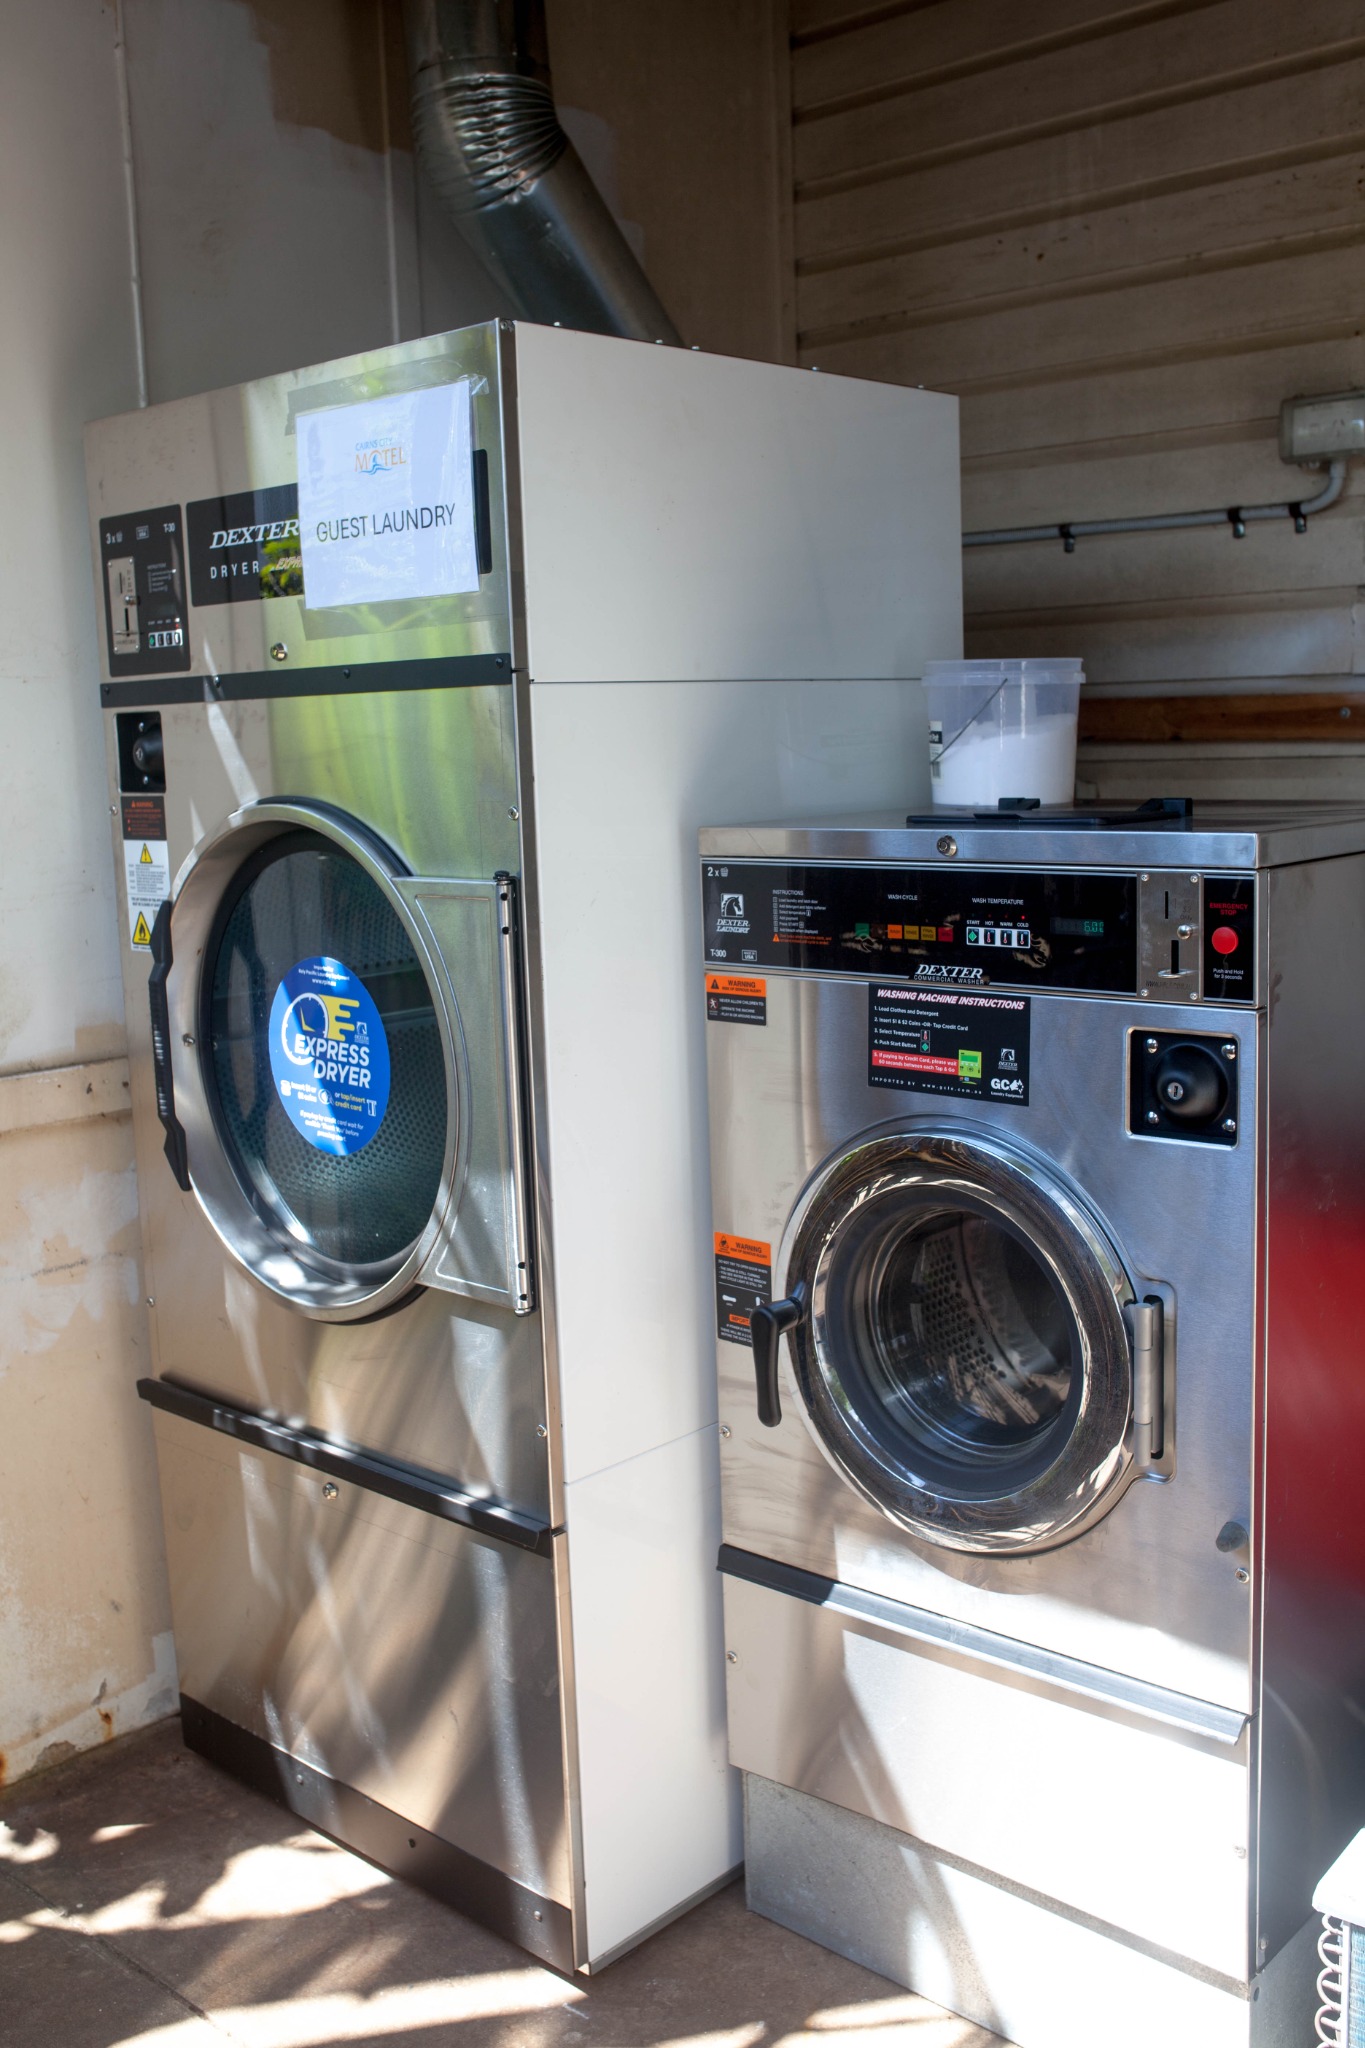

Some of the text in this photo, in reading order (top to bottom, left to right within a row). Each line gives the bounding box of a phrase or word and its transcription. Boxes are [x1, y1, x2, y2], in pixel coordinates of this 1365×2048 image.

[355, 437, 393, 451] CAIRNS CITY
[354, 446, 406, 472] MOTEL
[316, 503, 456, 542] GUEST LAUNDRY
[210, 519, 300, 549] DEXTER
[210, 560, 259, 579] DRYER
[708, 866, 713, 877] 2
[716, 918, 748, 927] DEXTER
[710, 949, 726, 958] T-300
[915, 964, 983, 979] DEXTER
[728, 980, 755, 988] WARNING
[914, 975, 954, 983] COMMERCIAL
[877, 988, 1025, 1010] WASHING MACHINE INSTRUCTIONS
[893, 1030, 920, 1038] Temperature
[294, 1034, 370, 1066] EXPRESS
[932, 1058, 946, 1066] please
[314, 1060, 371, 1089] DRYER
[872, 1076, 904, 1085] IMPORTED
[340, 1092, 366, 1104] tap/insert
[335, 1100, 362, 1112] credit card
[345, 1128, 359, 1137] before
[736, 1242, 762, 1253] WARNING
